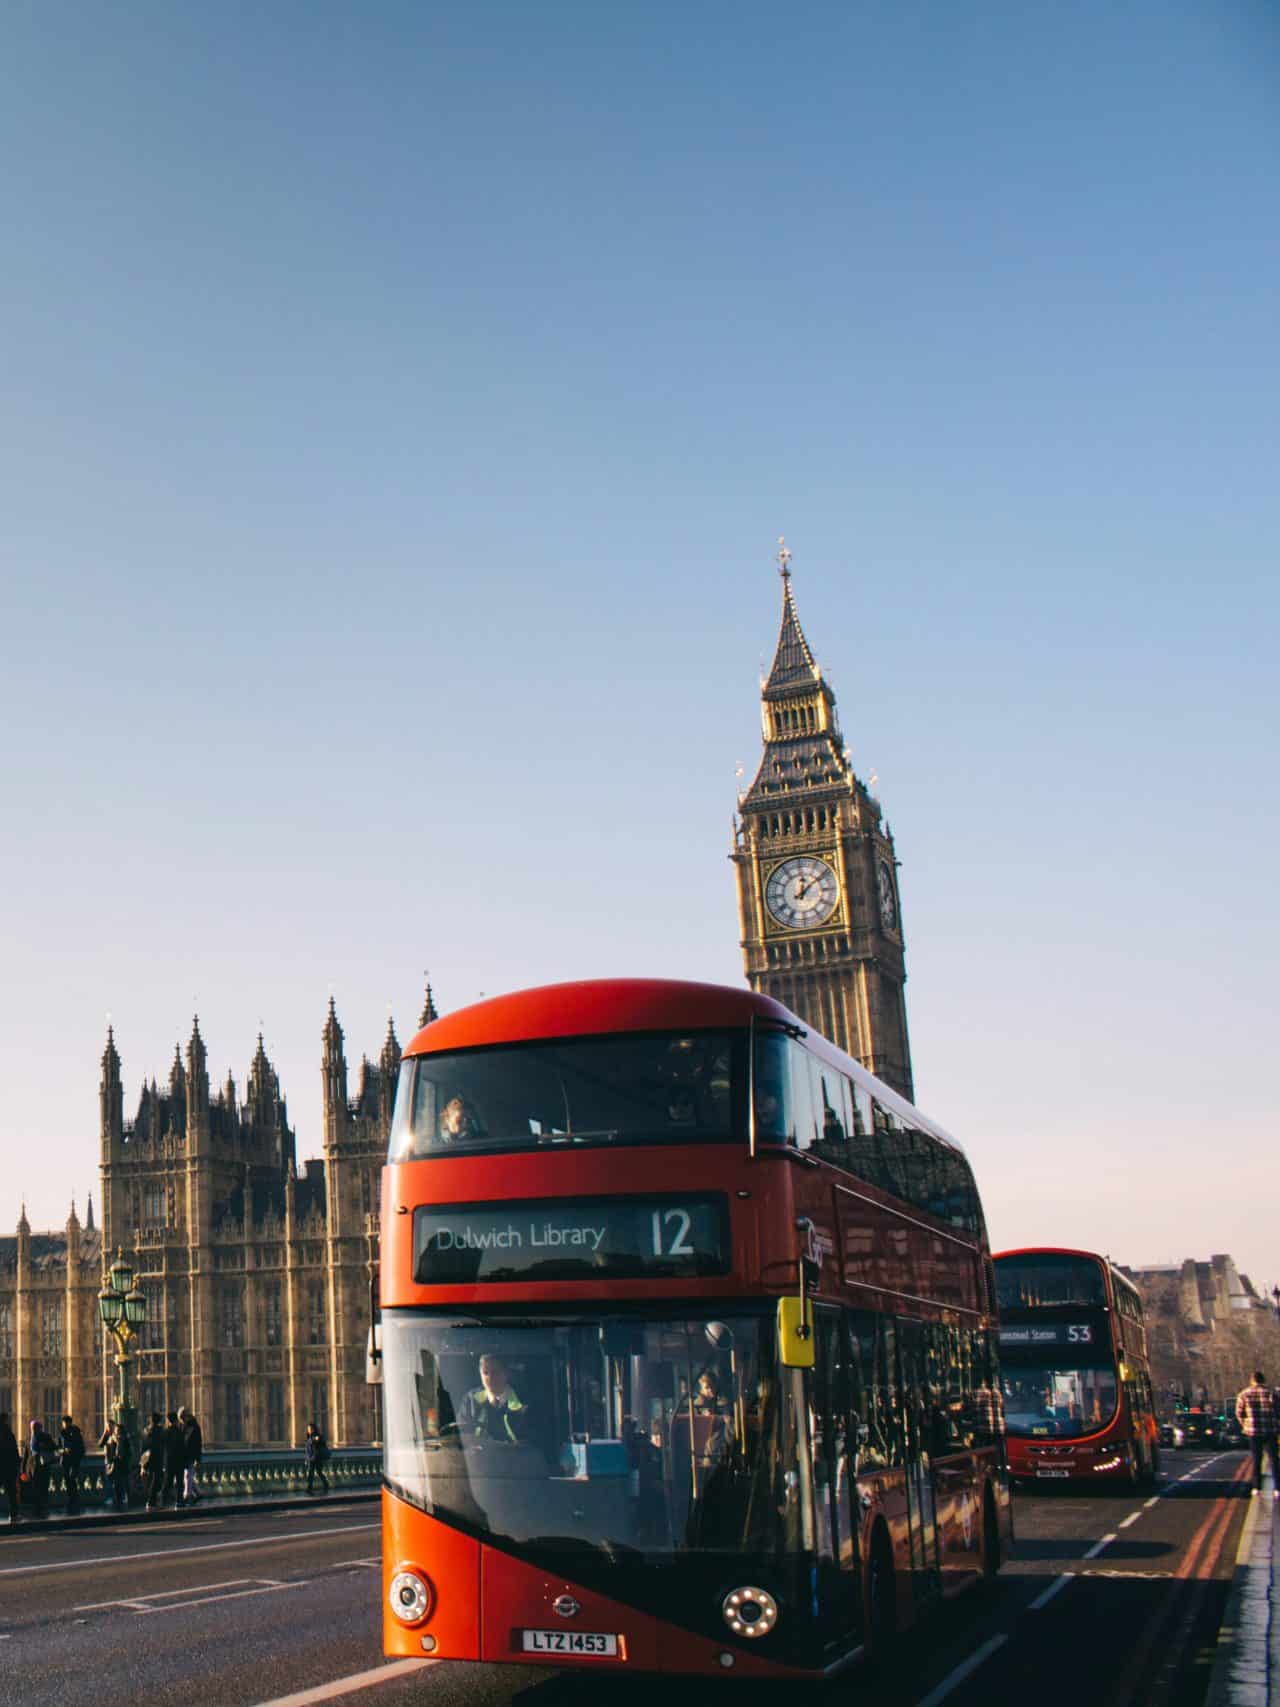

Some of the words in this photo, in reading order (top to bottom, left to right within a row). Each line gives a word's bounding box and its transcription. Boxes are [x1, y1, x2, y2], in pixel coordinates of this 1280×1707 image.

[436, 1224, 522, 1250] Dulwich
[530, 1223, 606, 1251] Library
[651, 1208, 695, 1256] 12
[1067, 1325, 1092, 1341] 53
